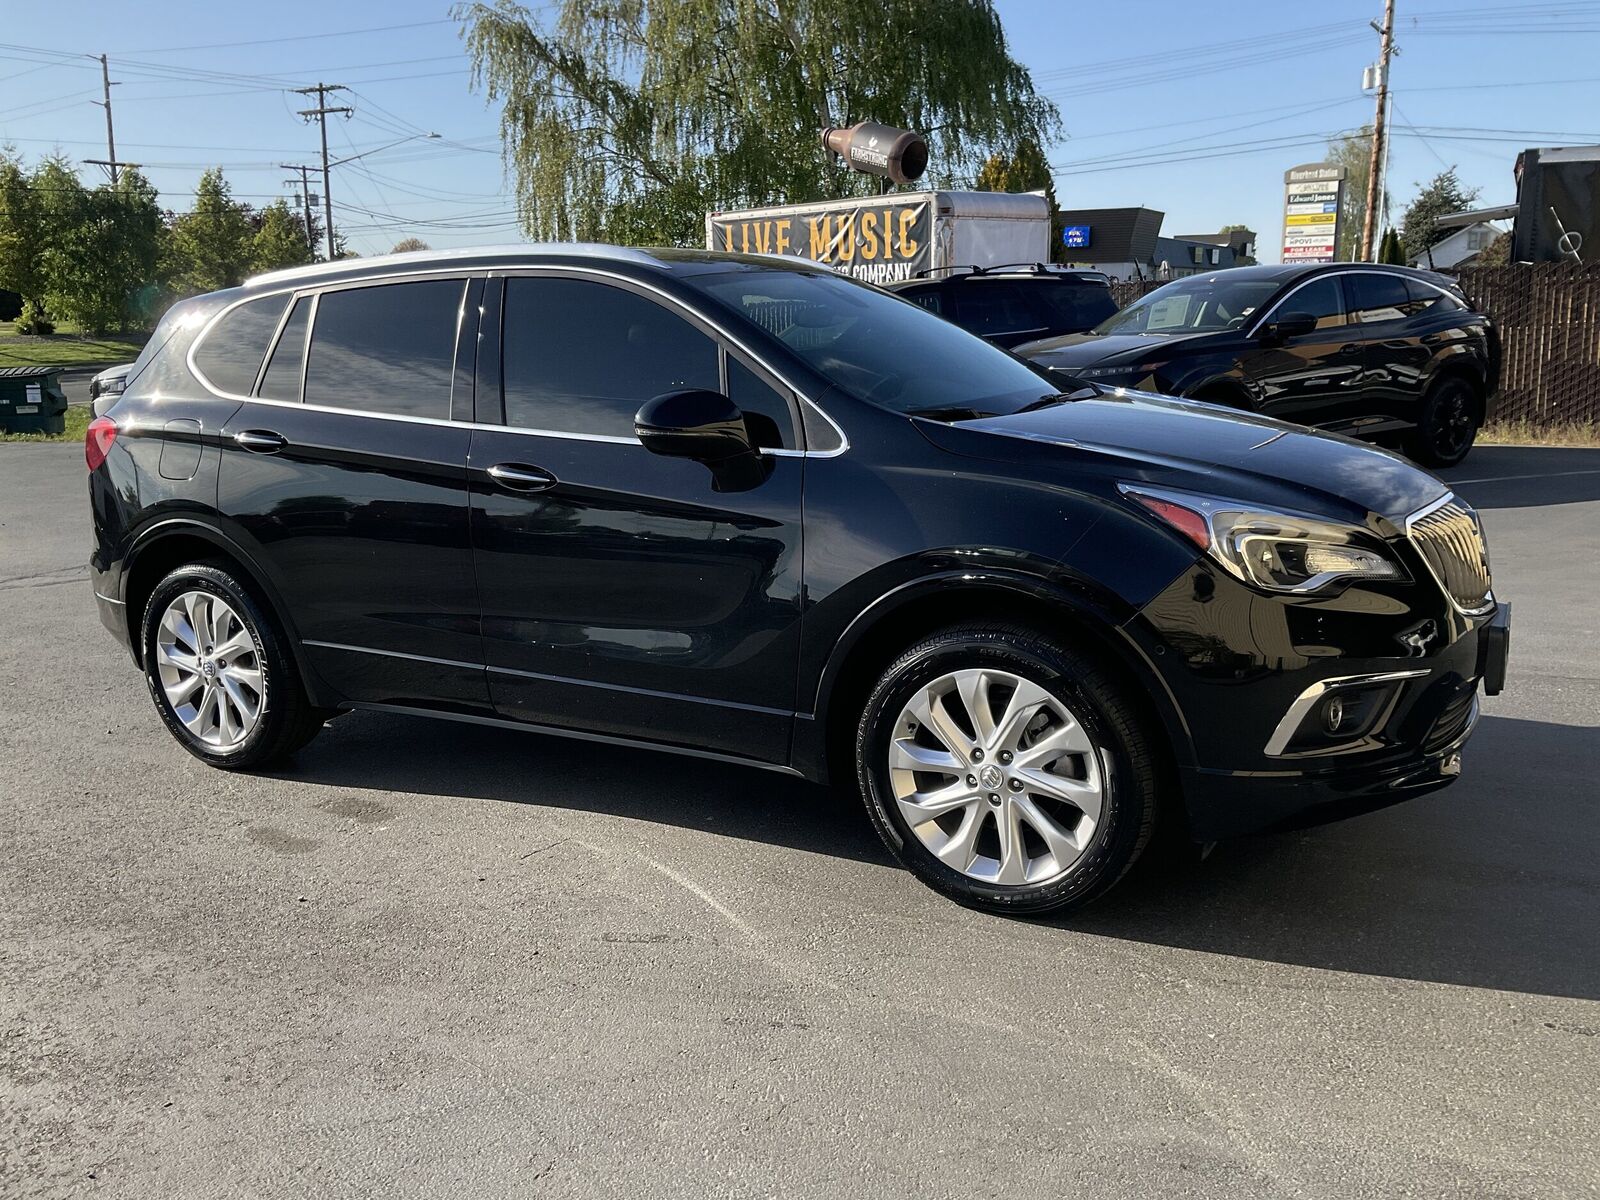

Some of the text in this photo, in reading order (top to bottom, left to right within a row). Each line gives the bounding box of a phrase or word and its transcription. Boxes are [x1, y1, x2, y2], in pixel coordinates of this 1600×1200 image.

[1290, 194, 1336, 203] Edward Jones
[725, 208, 917, 263] LIVE MUSIC
[852, 262, 912, 285] COMPANY
